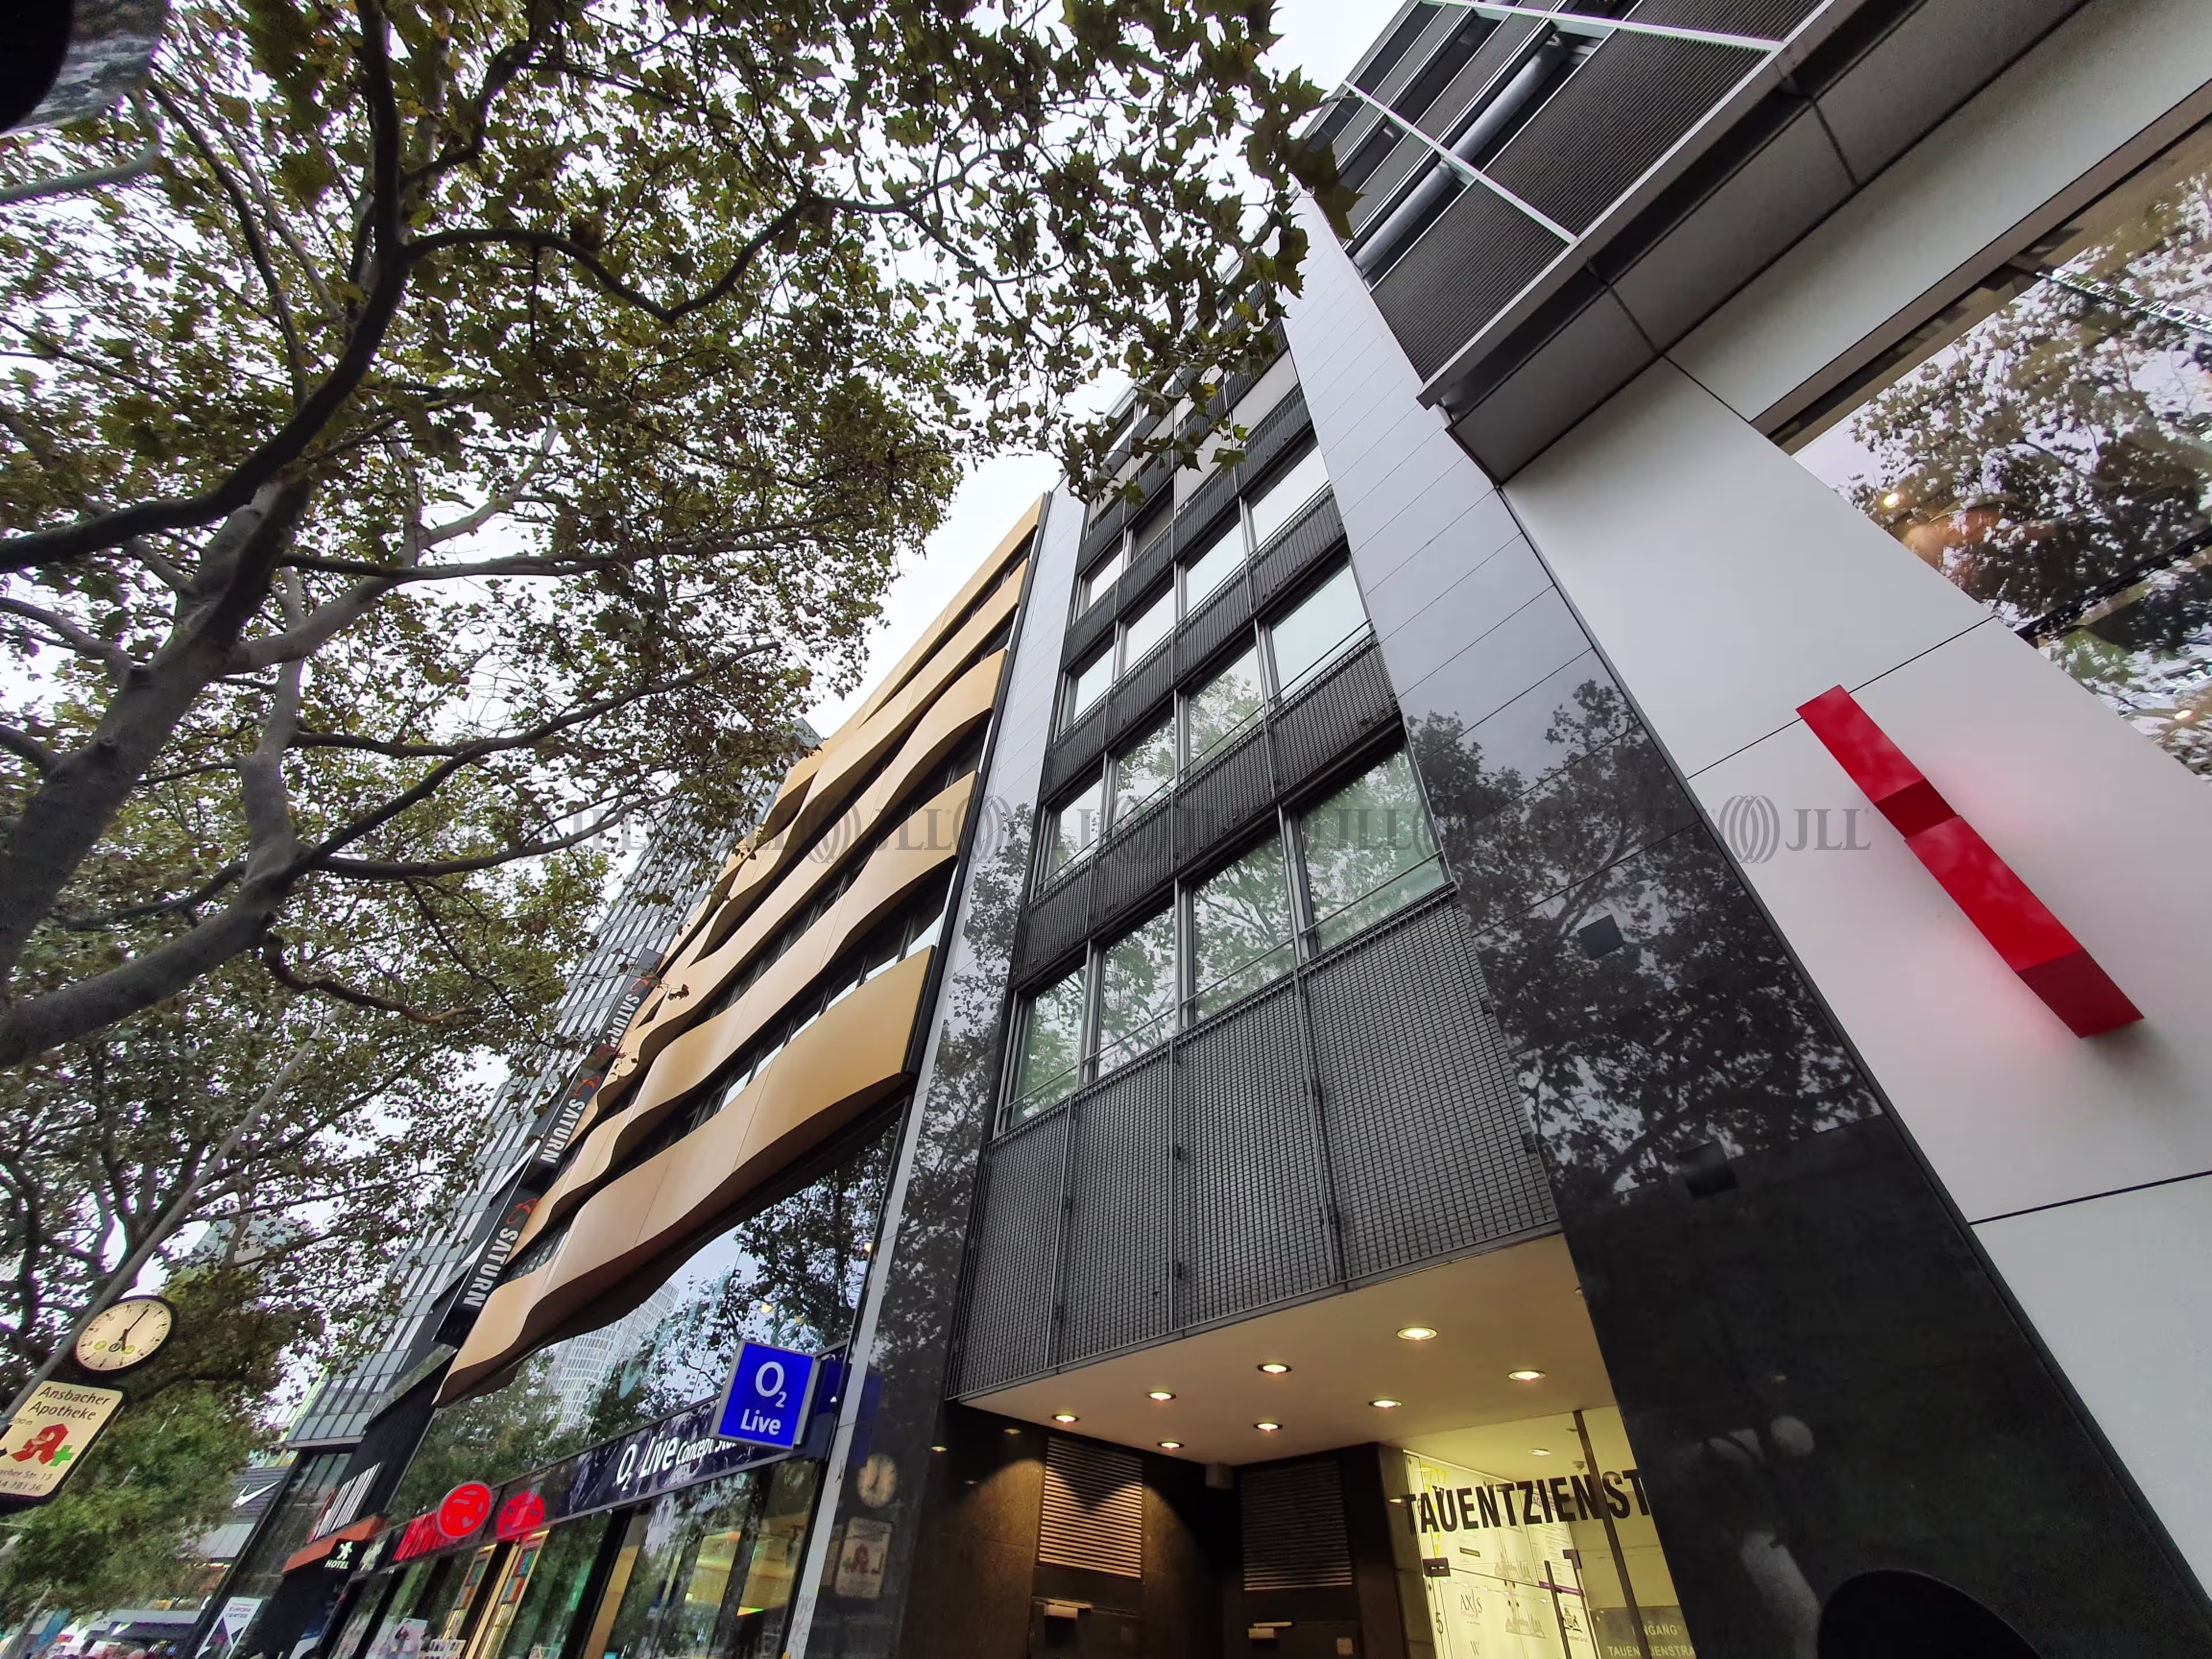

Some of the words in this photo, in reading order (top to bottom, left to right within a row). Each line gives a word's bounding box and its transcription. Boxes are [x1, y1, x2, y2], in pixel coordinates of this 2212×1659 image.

[540, 1099, 585, 1164] SATURN
[463, 1228, 518, 1307] SATURN
[38, 1387, 111, 1406] Ansbacher
[28, 1402, 97, 1420] Apotheke
[740, 1408, 781, 1435] Live
[638, 1431, 680, 1478] Live
[325, 1559, 349, 1570] HOTEL
